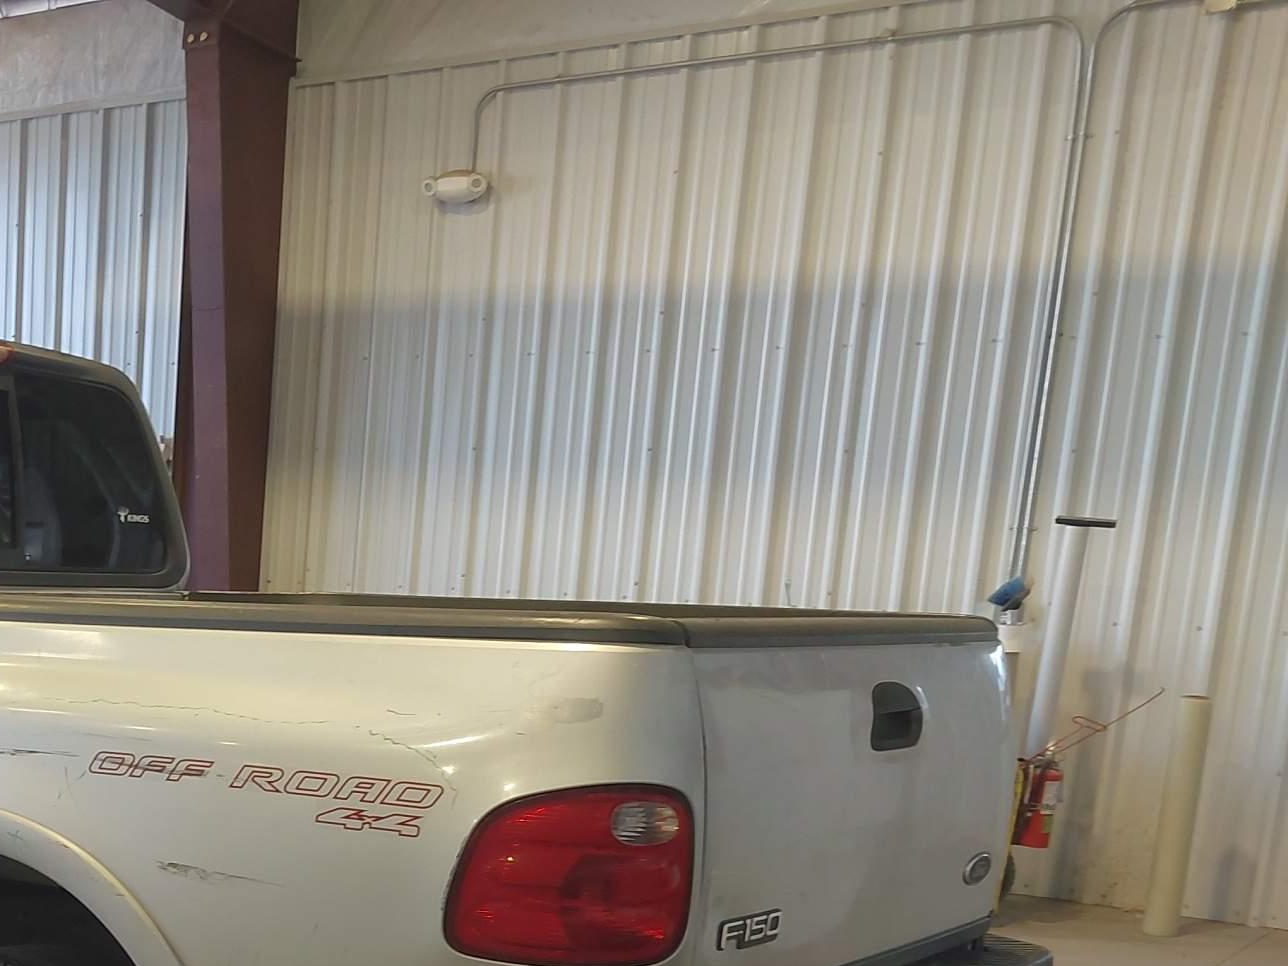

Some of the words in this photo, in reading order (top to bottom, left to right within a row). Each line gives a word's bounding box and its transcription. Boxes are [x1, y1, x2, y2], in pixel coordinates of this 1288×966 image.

[88, 750, 214, 782] OFF
[229, 764, 445, 809] ROAD
[718, 909, 783, 951] F150
